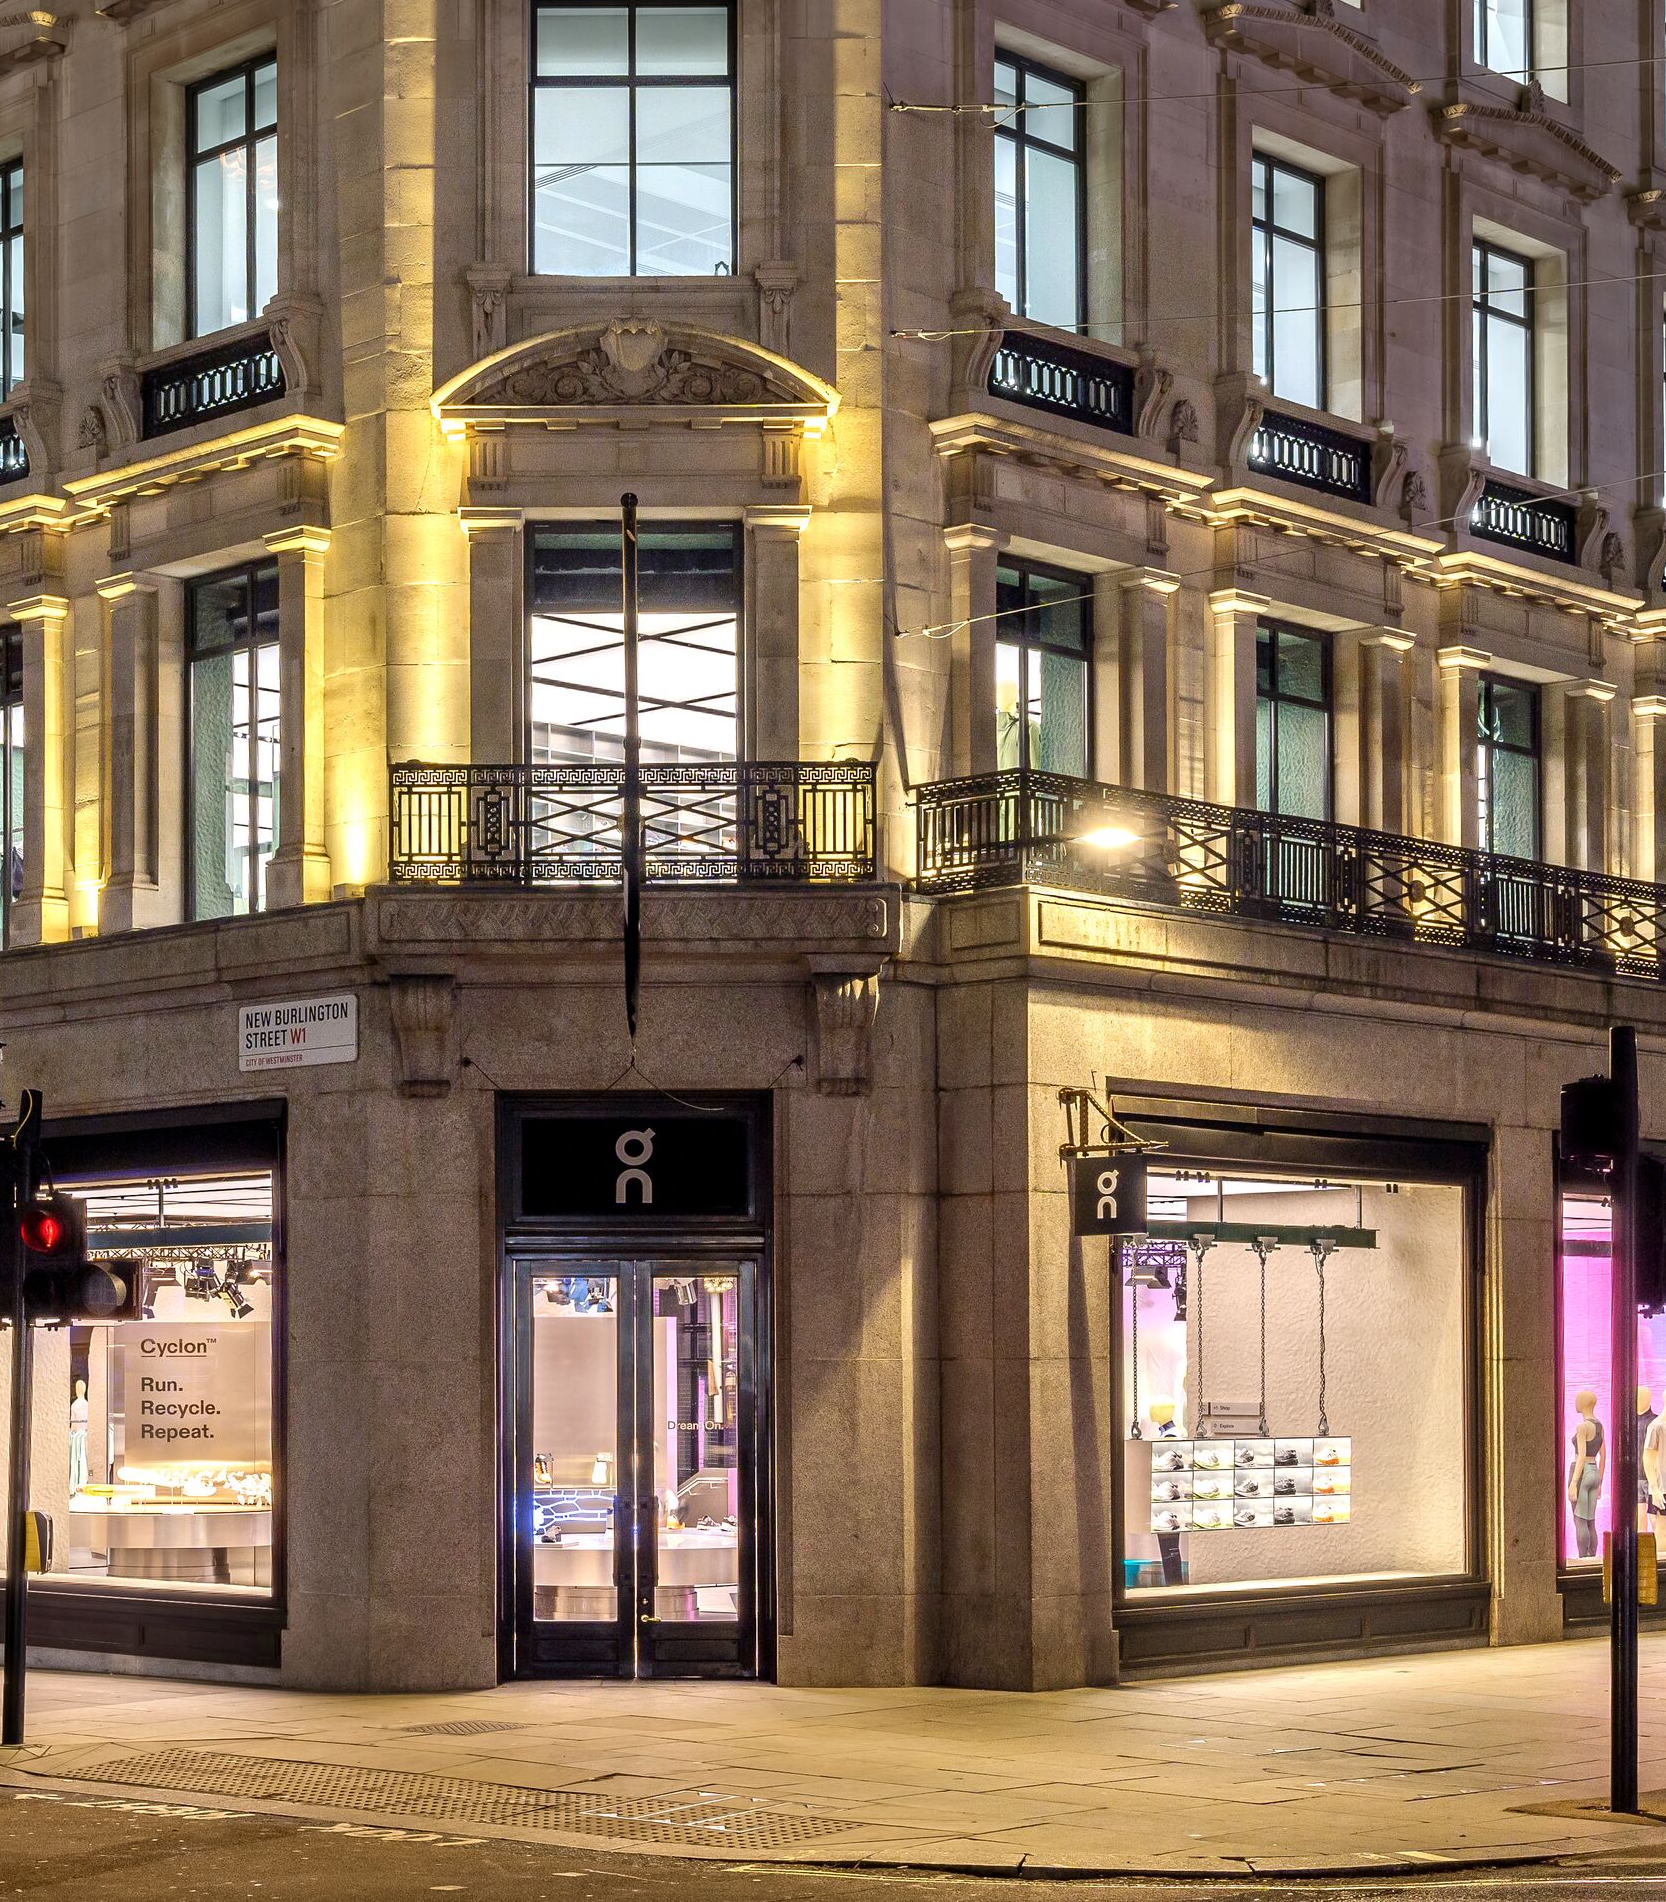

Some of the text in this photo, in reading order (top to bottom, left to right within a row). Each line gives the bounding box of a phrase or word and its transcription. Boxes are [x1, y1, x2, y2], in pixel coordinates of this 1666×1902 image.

[245, 1002, 348, 1029] NEW BURLINGTON
[245, 1027, 307, 1049] STREET W1
[245, 1054, 303, 1067] CITY OF WESTMINSTER
[140, 1377, 184, 1392] Run.
[141, 1400, 221, 1418] Recycle.
[141, 1424, 215, 1442] Repeat.
